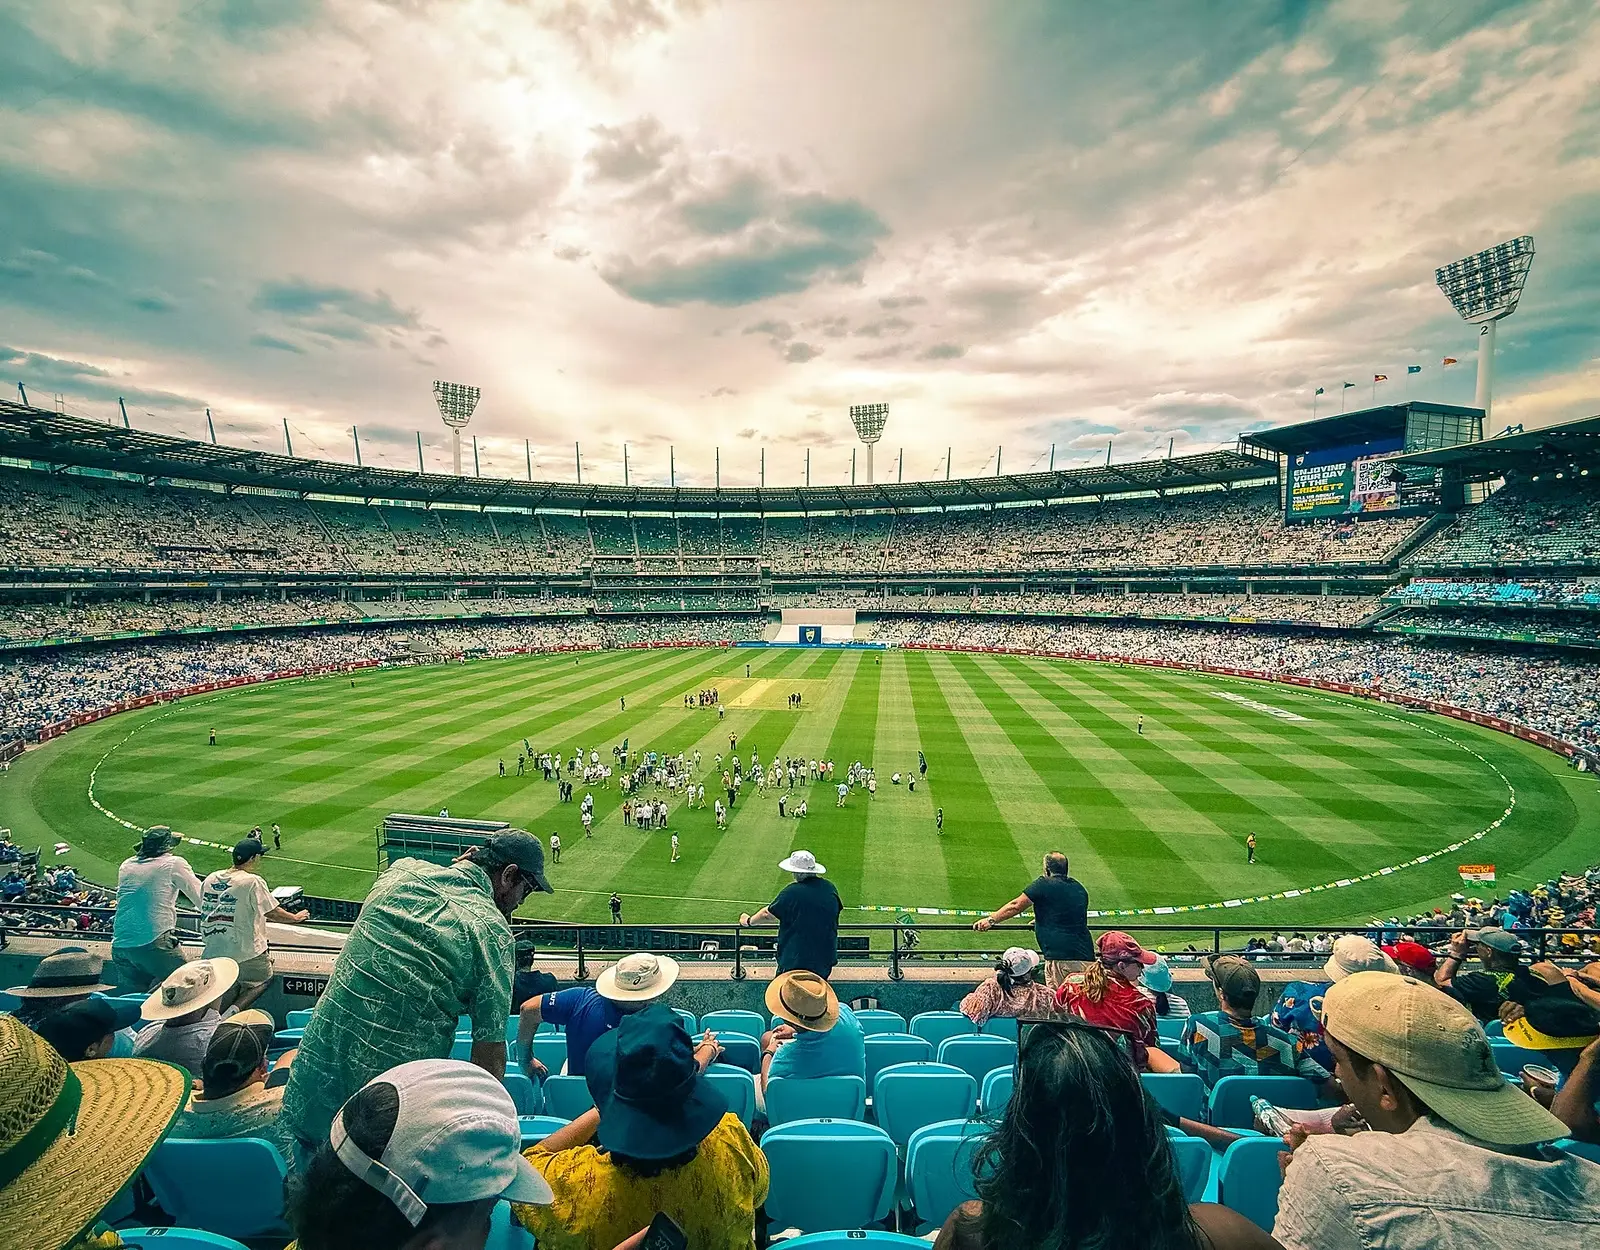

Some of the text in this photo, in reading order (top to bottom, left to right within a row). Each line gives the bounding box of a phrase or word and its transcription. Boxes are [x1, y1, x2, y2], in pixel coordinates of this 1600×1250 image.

[1480, 325, 1488, 336] 2
[1293, 463, 1346, 476] ENJOYING
[1294, 470, 1344, 482] YOUR DAY
[1308, 478, 1328, 486] THE
[1293, 483, 1344, 494] CRICKET?
[296, 981, 314, 992] P18
